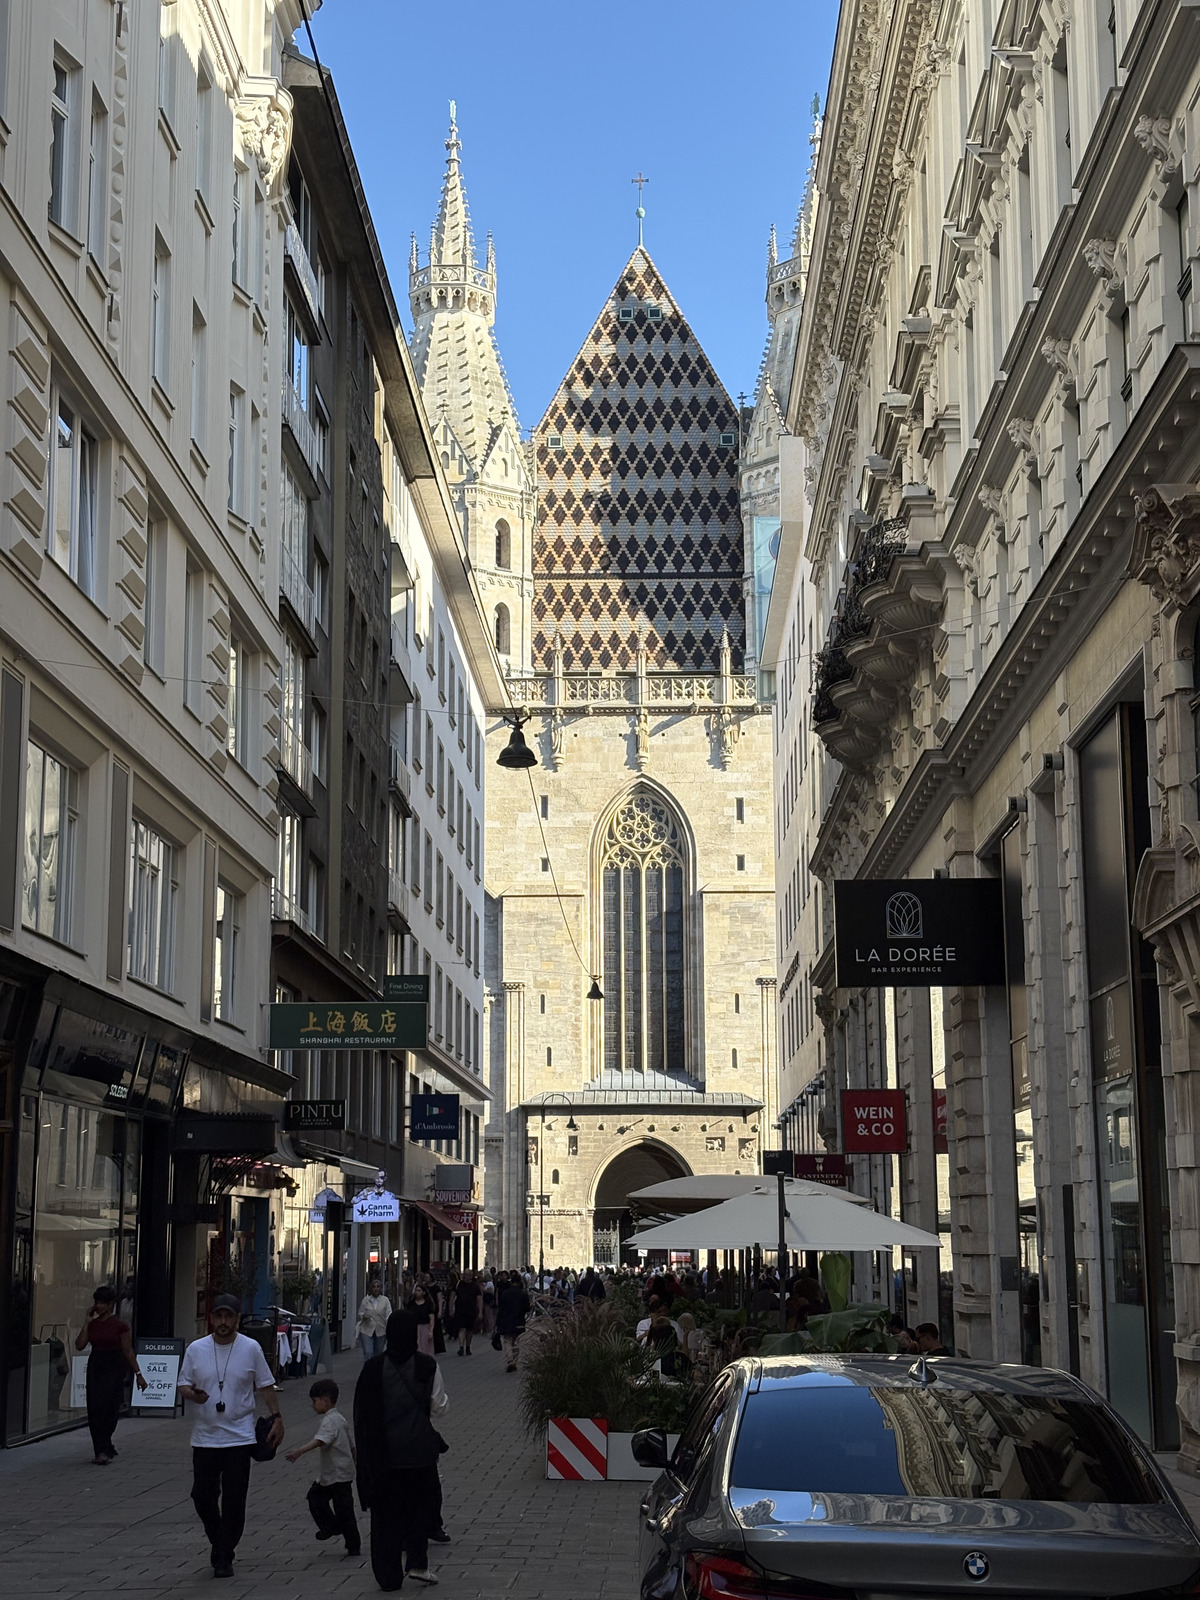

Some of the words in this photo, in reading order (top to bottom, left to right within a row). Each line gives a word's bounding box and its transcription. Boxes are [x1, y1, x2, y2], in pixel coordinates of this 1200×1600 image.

[855, 948, 881, 962] LA
[888, 944, 957, 962] DORÉE
[403, 983, 424, 991] Dining
[300, 1009, 397, 1034] 上海飯店
[290, 1104, 342, 1118] PINTU
[854, 1106, 894, 1119] WEIN
[436, 1191, 470, 1202] SOUVENIRS
